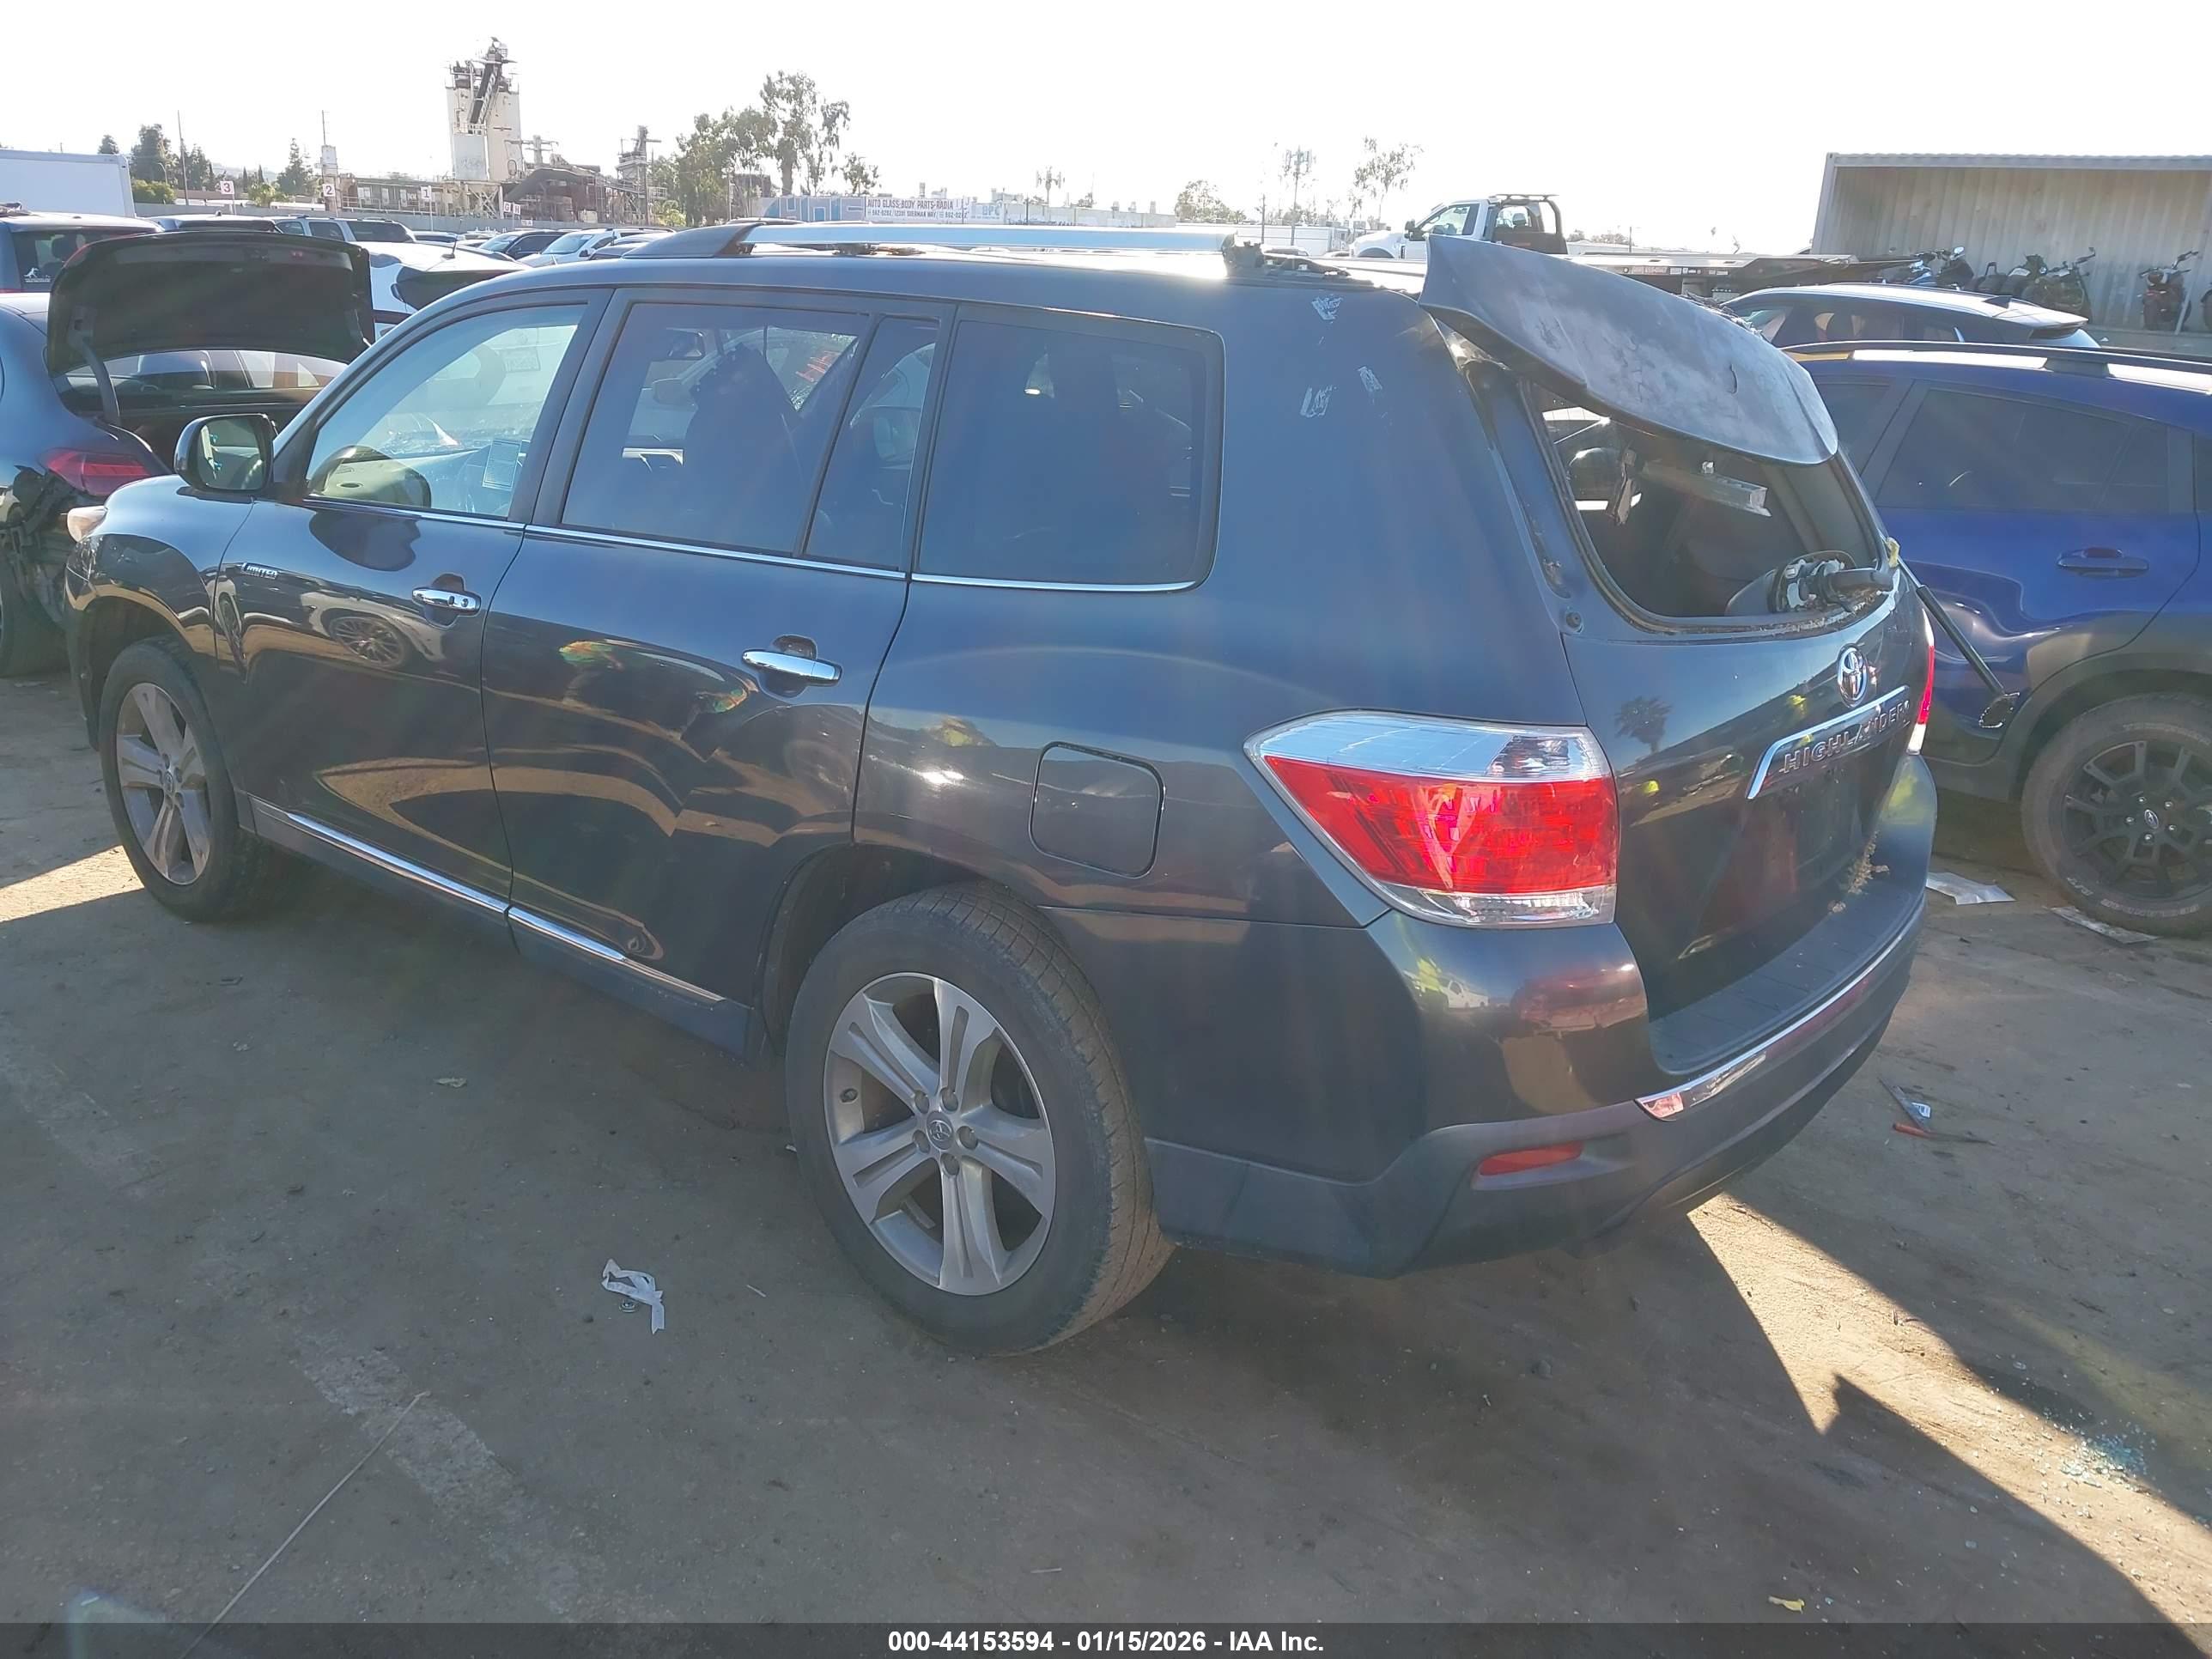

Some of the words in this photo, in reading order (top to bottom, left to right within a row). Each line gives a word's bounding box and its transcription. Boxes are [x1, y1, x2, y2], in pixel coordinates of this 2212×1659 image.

[223, 182, 231, 193] 3
[325, 185, 333, 195] 2
[423, 188, 429, 198] 1
[867, 198, 881, 208] AUTO
[1783, 701, 1905, 774] HIGHLANDER
